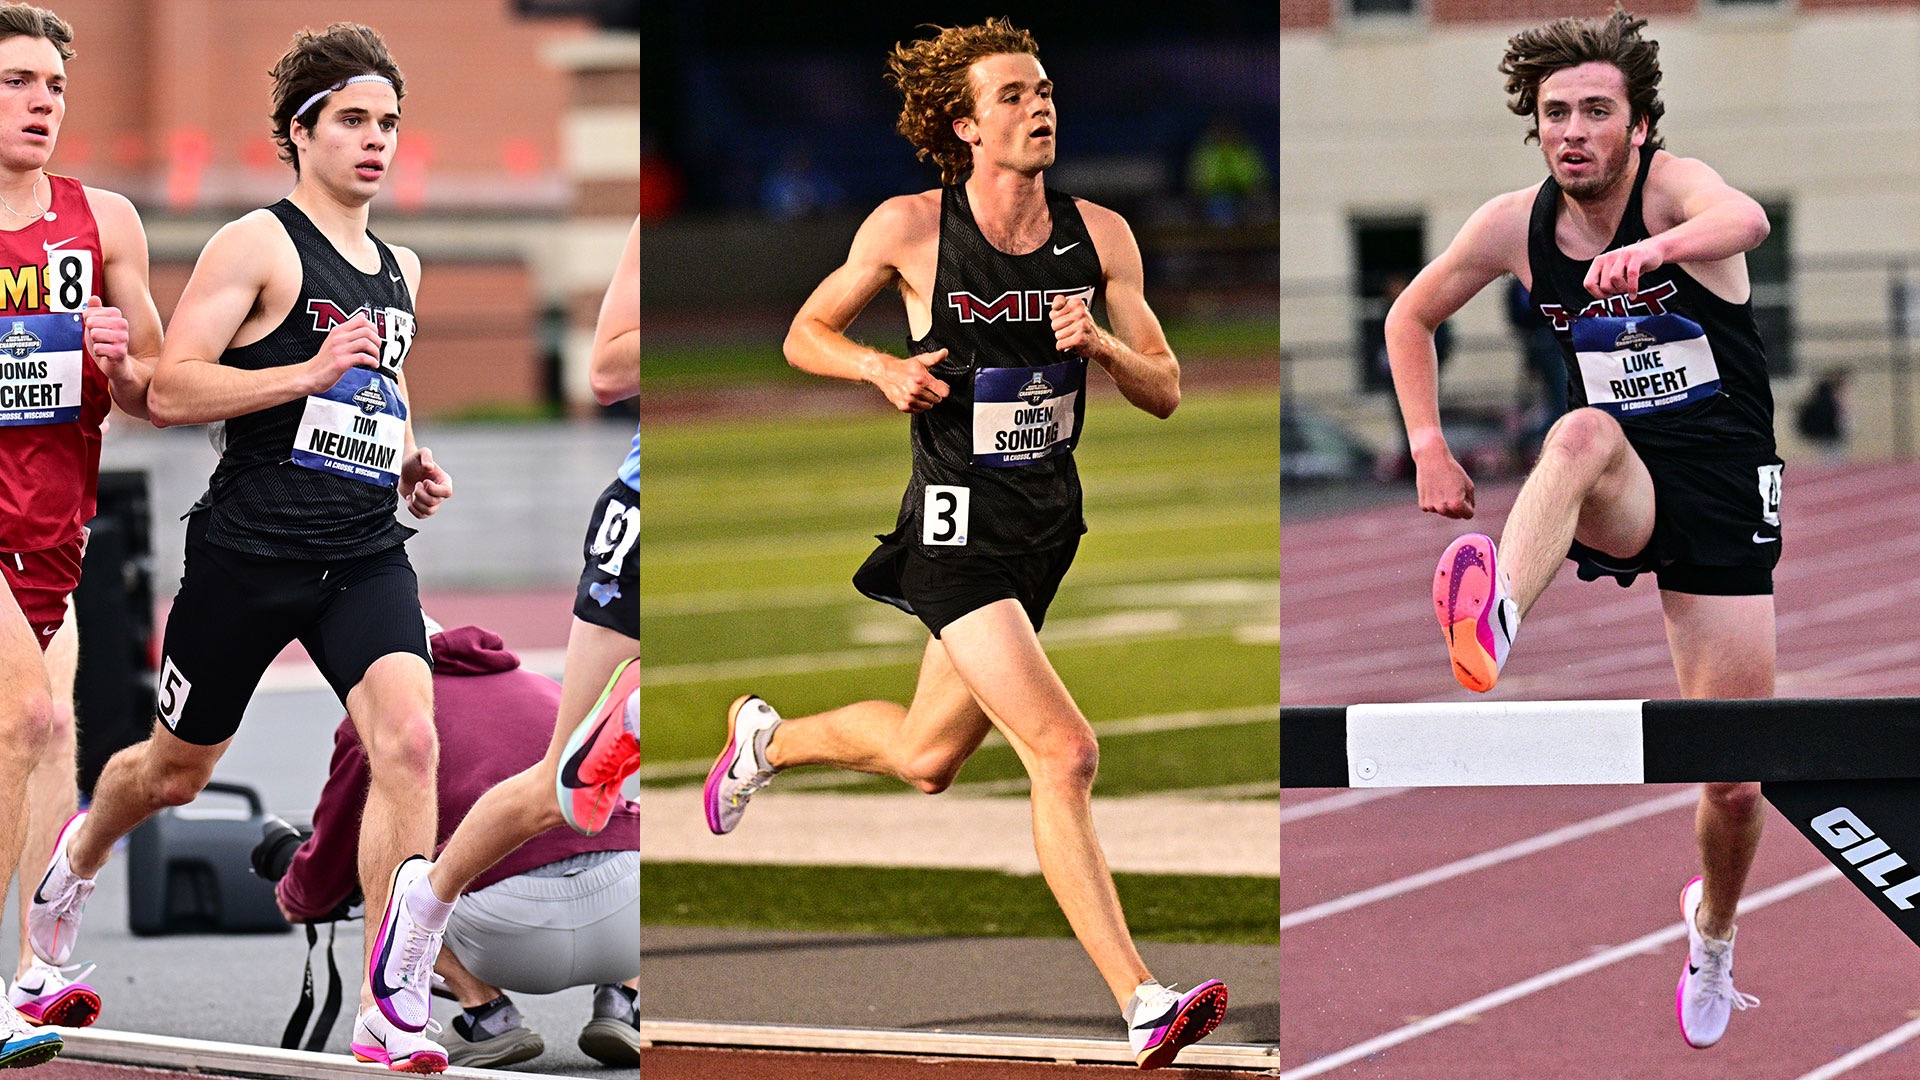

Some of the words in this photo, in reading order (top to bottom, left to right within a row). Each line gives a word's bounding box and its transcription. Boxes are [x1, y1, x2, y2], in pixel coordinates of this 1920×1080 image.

[60, 256, 82, 309] 8
[1622, 351, 1663, 374] LUKE
[0, 383, 62, 408] CKERT
[1609, 366, 1688, 400] RUPERT
[353, 415, 378, 437] TIM
[1014, 406, 1054, 426] OWEN
[309, 428, 397, 470] NEUMANN
[995, 422, 1059, 451] SONDAG
[324, 459, 333, 468] LA
[933, 492, 957, 542] 3
[599, 513, 628, 565] 9
[160, 669, 182, 716] 5
[1810, 807, 1920, 911] GILL
